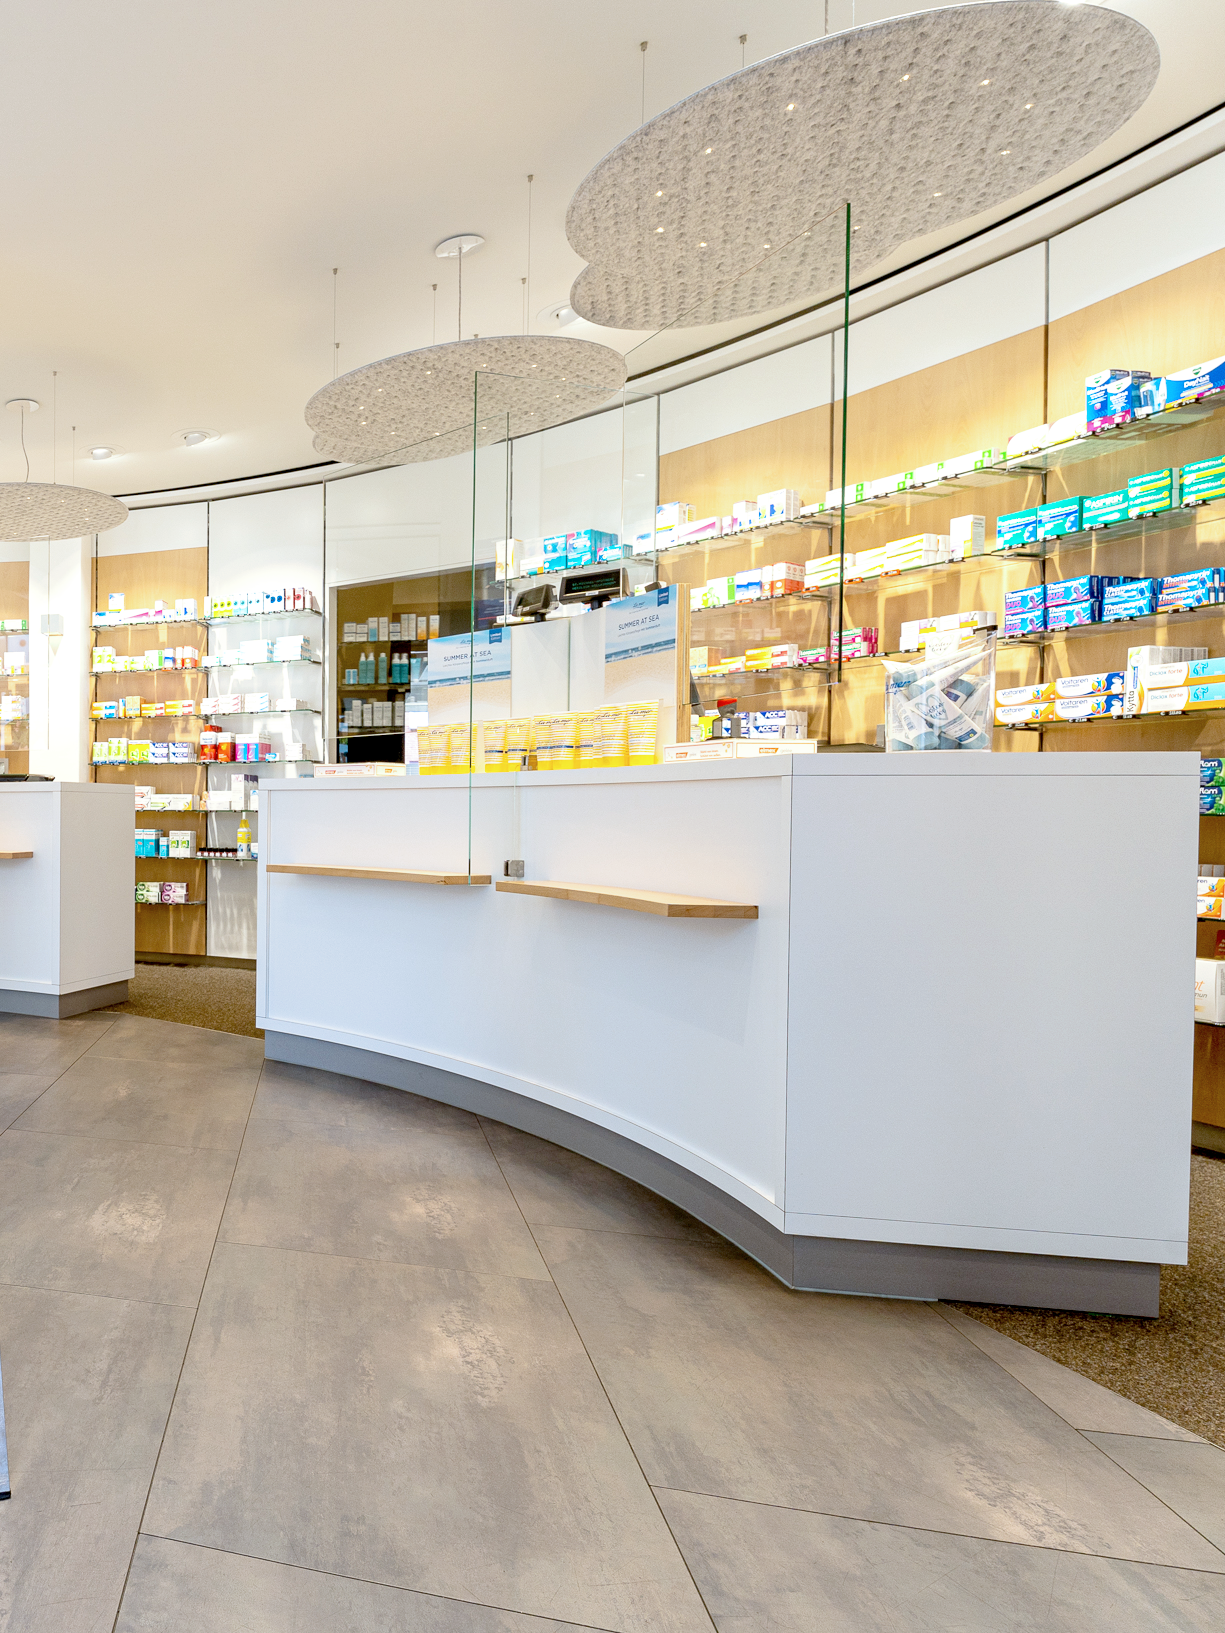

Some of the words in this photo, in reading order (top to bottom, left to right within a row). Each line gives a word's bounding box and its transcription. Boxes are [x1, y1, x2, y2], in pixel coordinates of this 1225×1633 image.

[1090, 494, 1125, 508] ASPIRIN
[1163, 570, 1210, 584] Thomapyrin
[1105, 580, 1148, 594] Thomapyrin
[1047, 592, 1064, 600] DUO
[1158, 589, 1206, 601] Thomapyrin
[1104, 600, 1147, 611] Thomapyrin
[618, 620, 639, 631] SUMMER
[649, 614, 659, 622] SEA
[1049, 615, 1066, 623] DUO
[1005, 623, 1021, 631] DUO
[443, 653, 468, 662] SUMMER
[1061, 677, 1089, 685] Voltaren
[1060, 699, 1088, 707] Voltaren
[1127, 690, 1135, 713] Kytta
